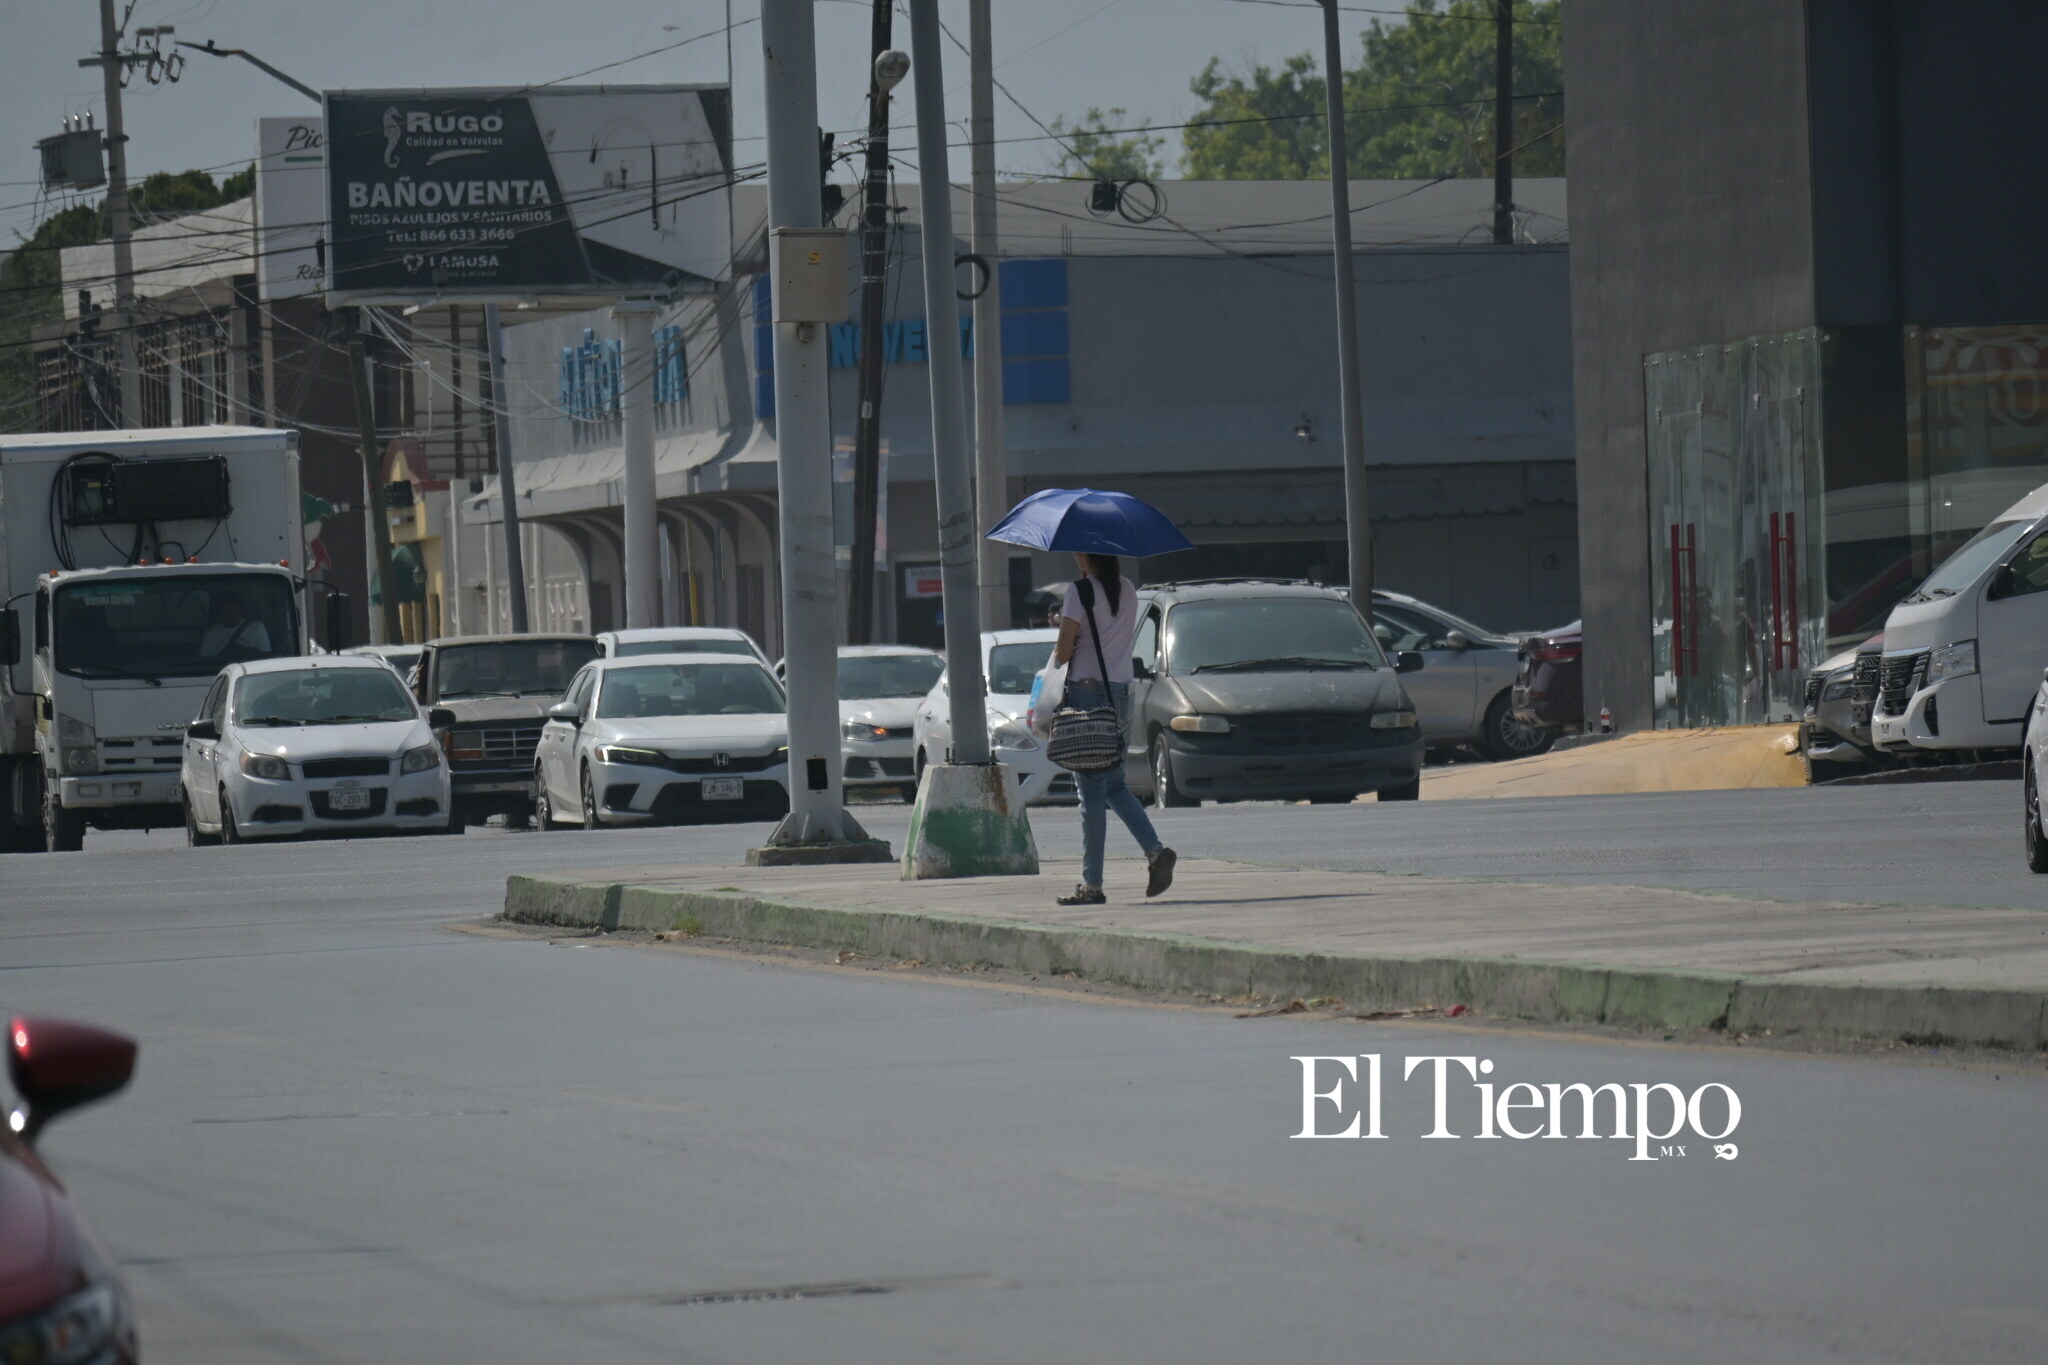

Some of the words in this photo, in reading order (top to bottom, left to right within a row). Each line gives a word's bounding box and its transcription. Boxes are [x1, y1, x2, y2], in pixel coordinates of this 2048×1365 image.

[406, 137, 444, 147] Calidad
[446, 139, 459, 147] en
[347, 175, 552, 208] BAÑOVENTA
[350, 214, 389, 226] PISOS
[391, 212, 459, 225] AZULEJOS
[473, 210, 553, 224] SANITARIOS
[419, 229, 447, 242] 866
[449, 229, 476, 241] 633
[479, 228, 515, 241] 3666
